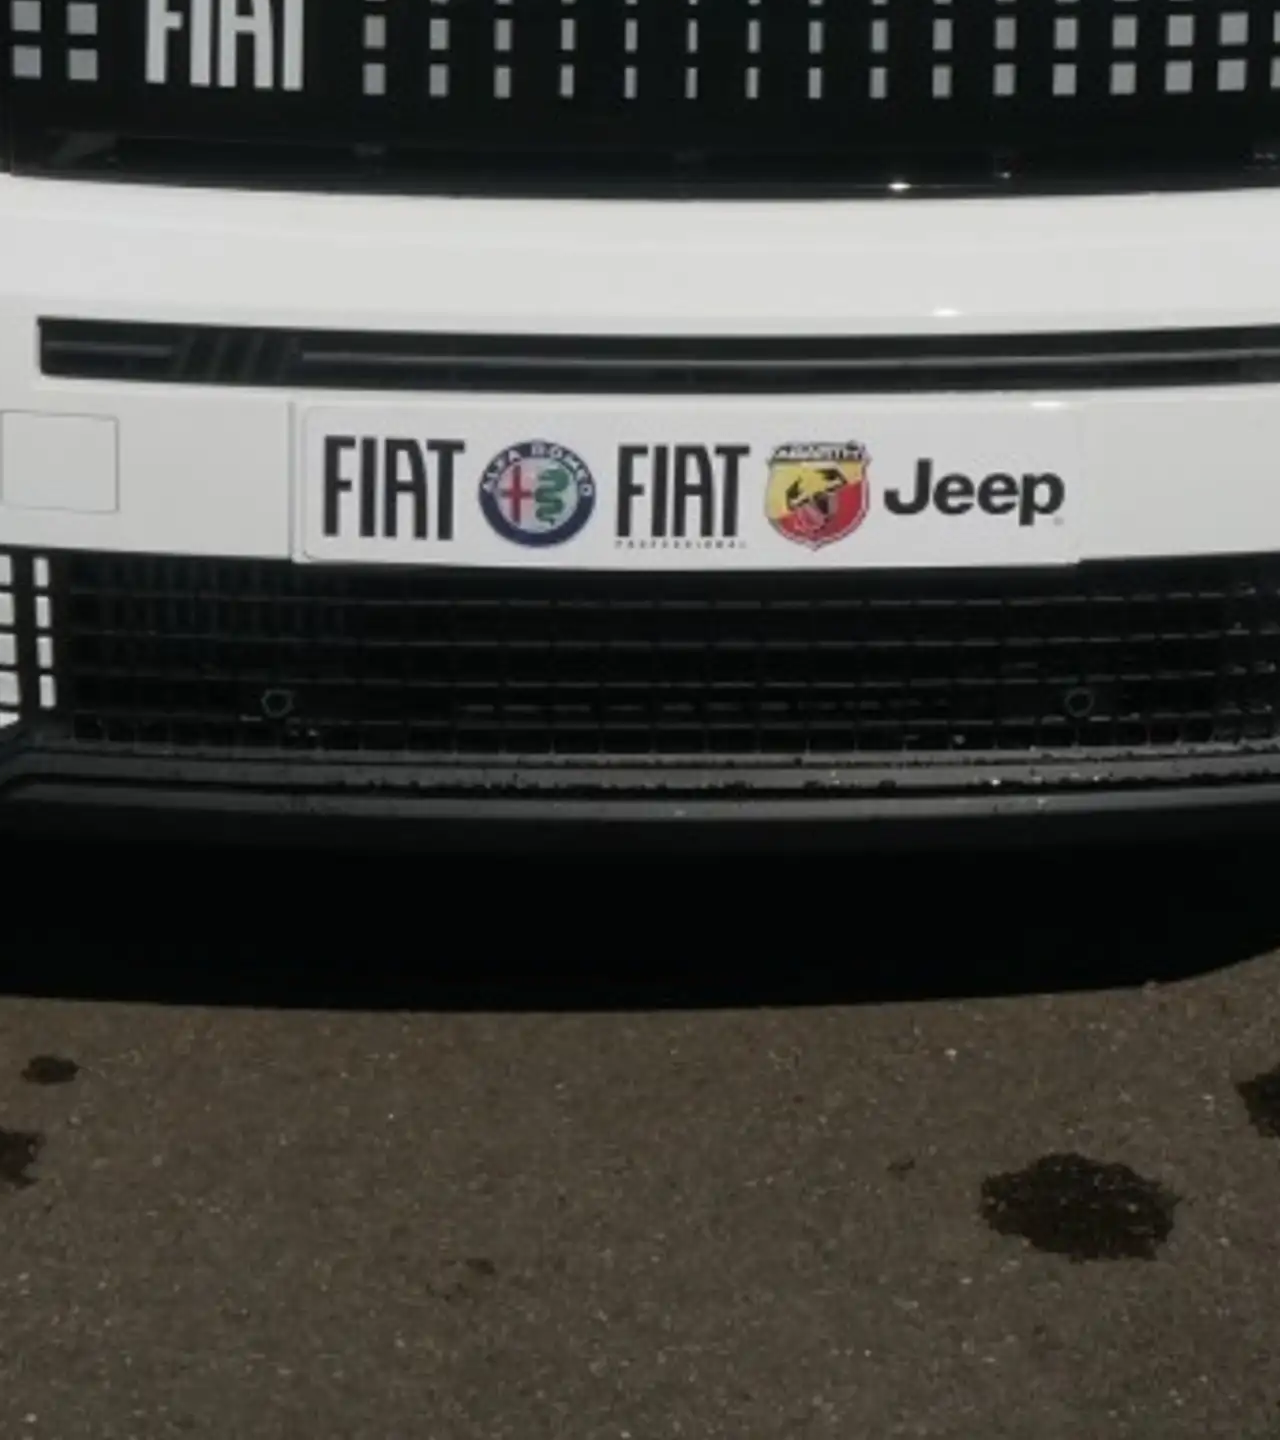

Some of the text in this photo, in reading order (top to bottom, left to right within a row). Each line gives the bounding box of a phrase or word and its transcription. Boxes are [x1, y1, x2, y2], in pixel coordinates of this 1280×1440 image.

[323, 435, 466, 541] FIAT
[617, 443, 751, 538] FIAT
[883, 457, 1066, 527] Jeep
